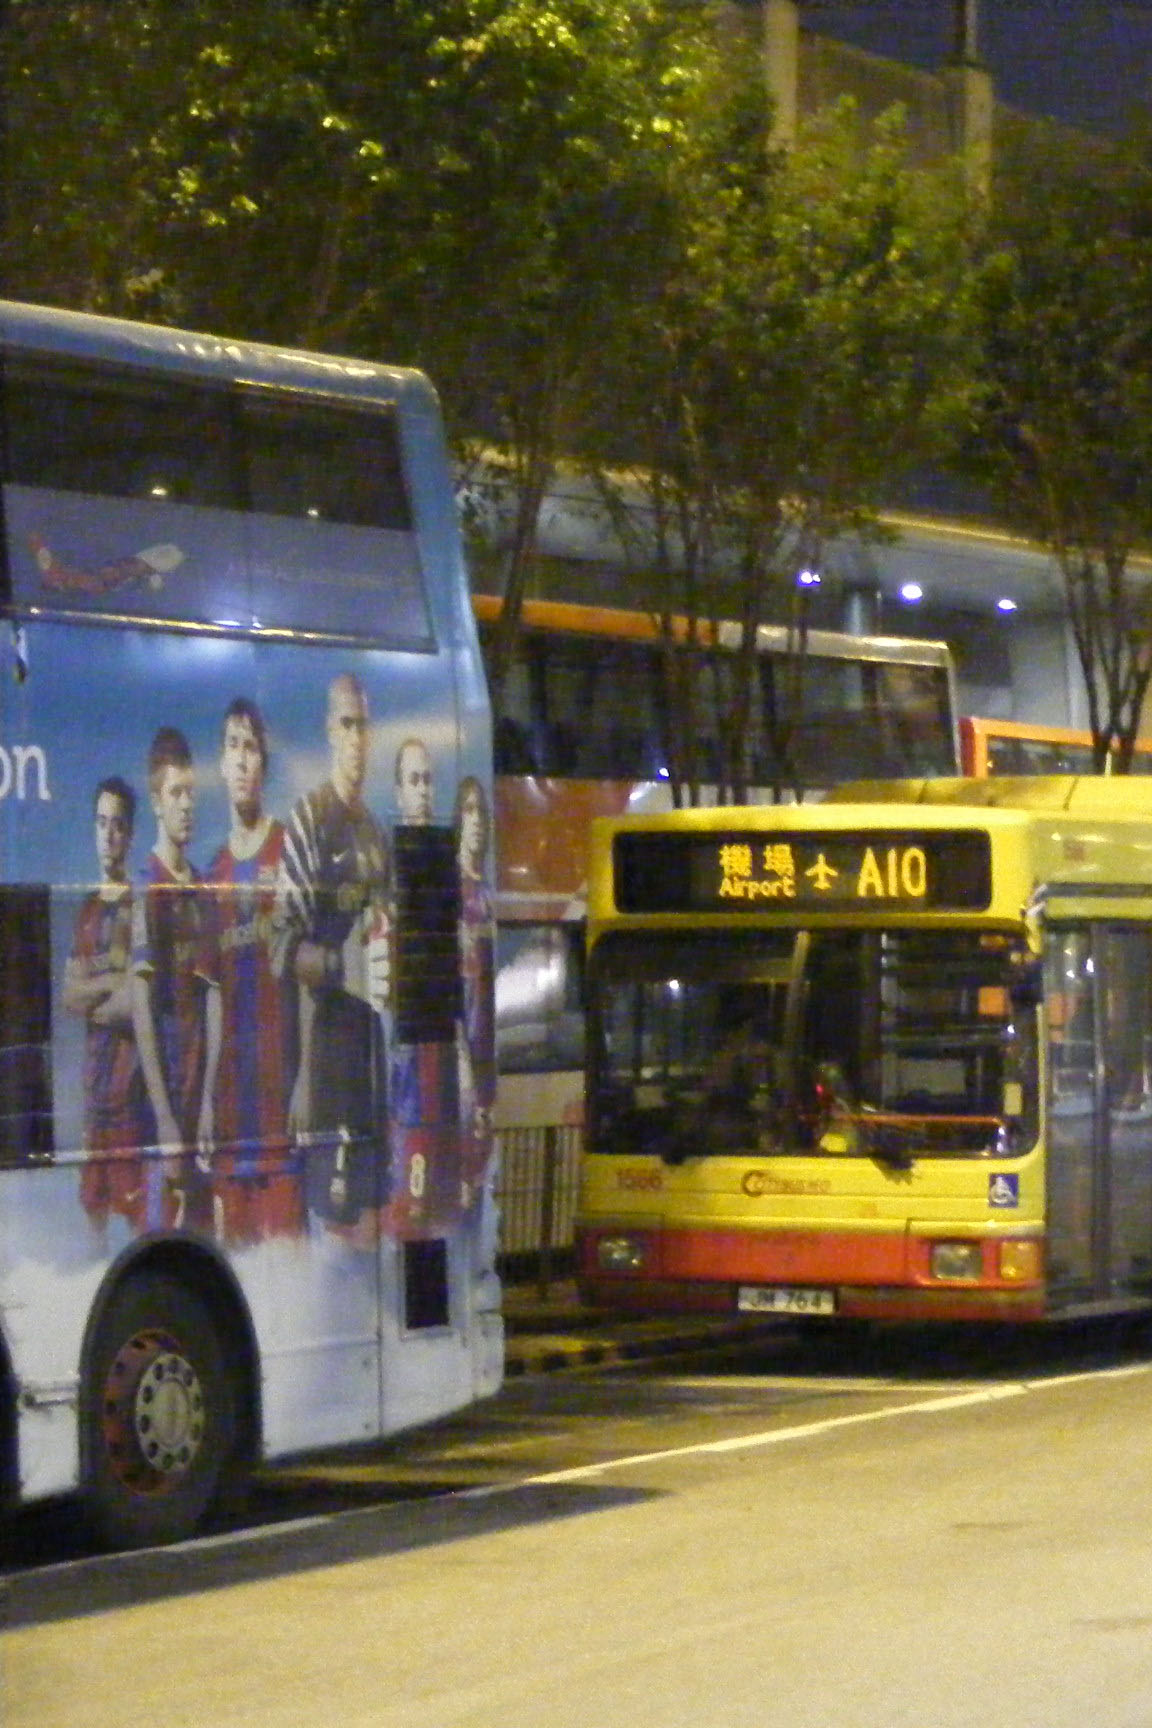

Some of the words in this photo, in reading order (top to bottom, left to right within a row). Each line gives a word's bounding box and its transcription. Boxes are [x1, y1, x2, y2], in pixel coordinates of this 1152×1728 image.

[719, 876, 796, 899] Airport
[857, 847, 926, 898] A10
[410, 1152, 425, 1198] 8
